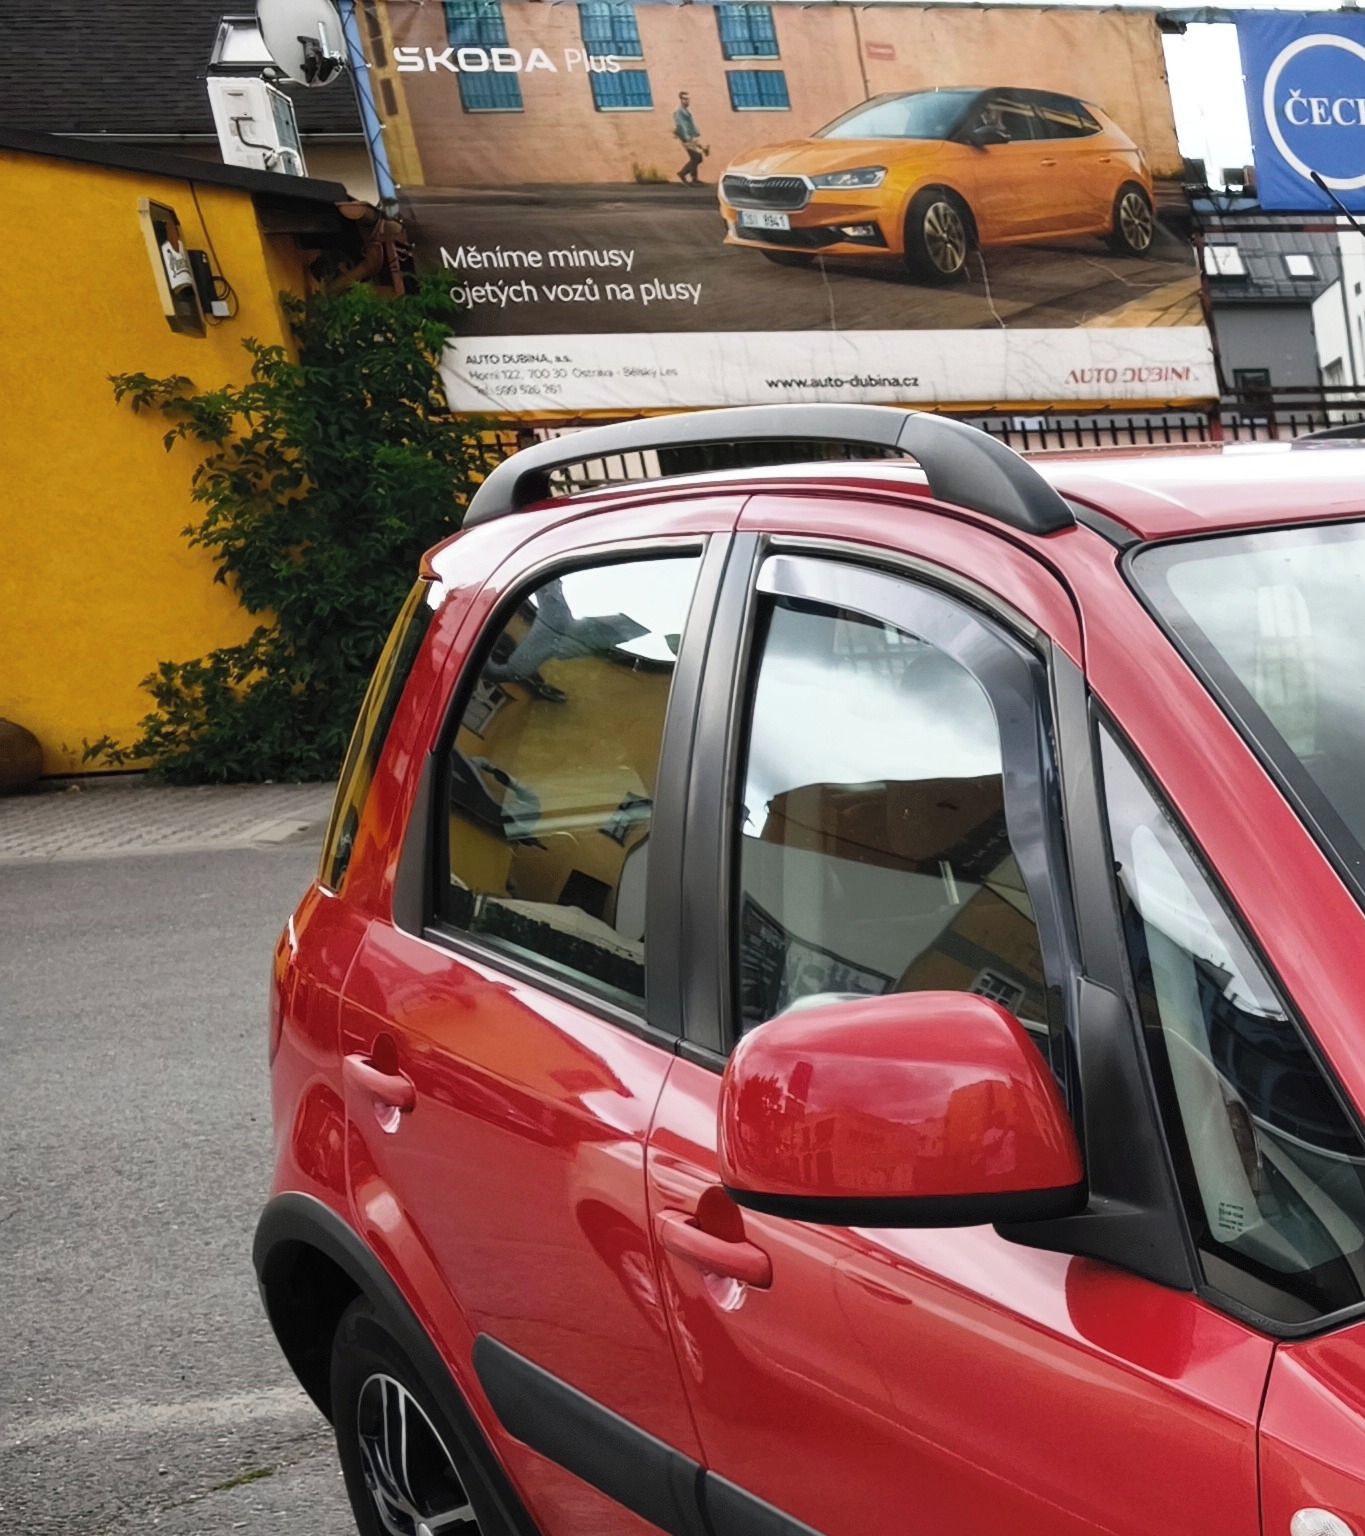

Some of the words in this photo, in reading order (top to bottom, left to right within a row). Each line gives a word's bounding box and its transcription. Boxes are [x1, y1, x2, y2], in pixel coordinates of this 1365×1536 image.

[564, 48, 622, 73] Plus
[440, 245, 543, 270] Měníme
[549, 245, 635, 272] minusy
[450, 278, 538, 309] ojetých
[541, 277, 601, 301] vozů
[605, 286, 634, 301] na
[640, 277, 702, 306] plusy
[465, 354, 500, 365] AUTO
[765, 374, 919, 389] www.auto-dubina.cz
